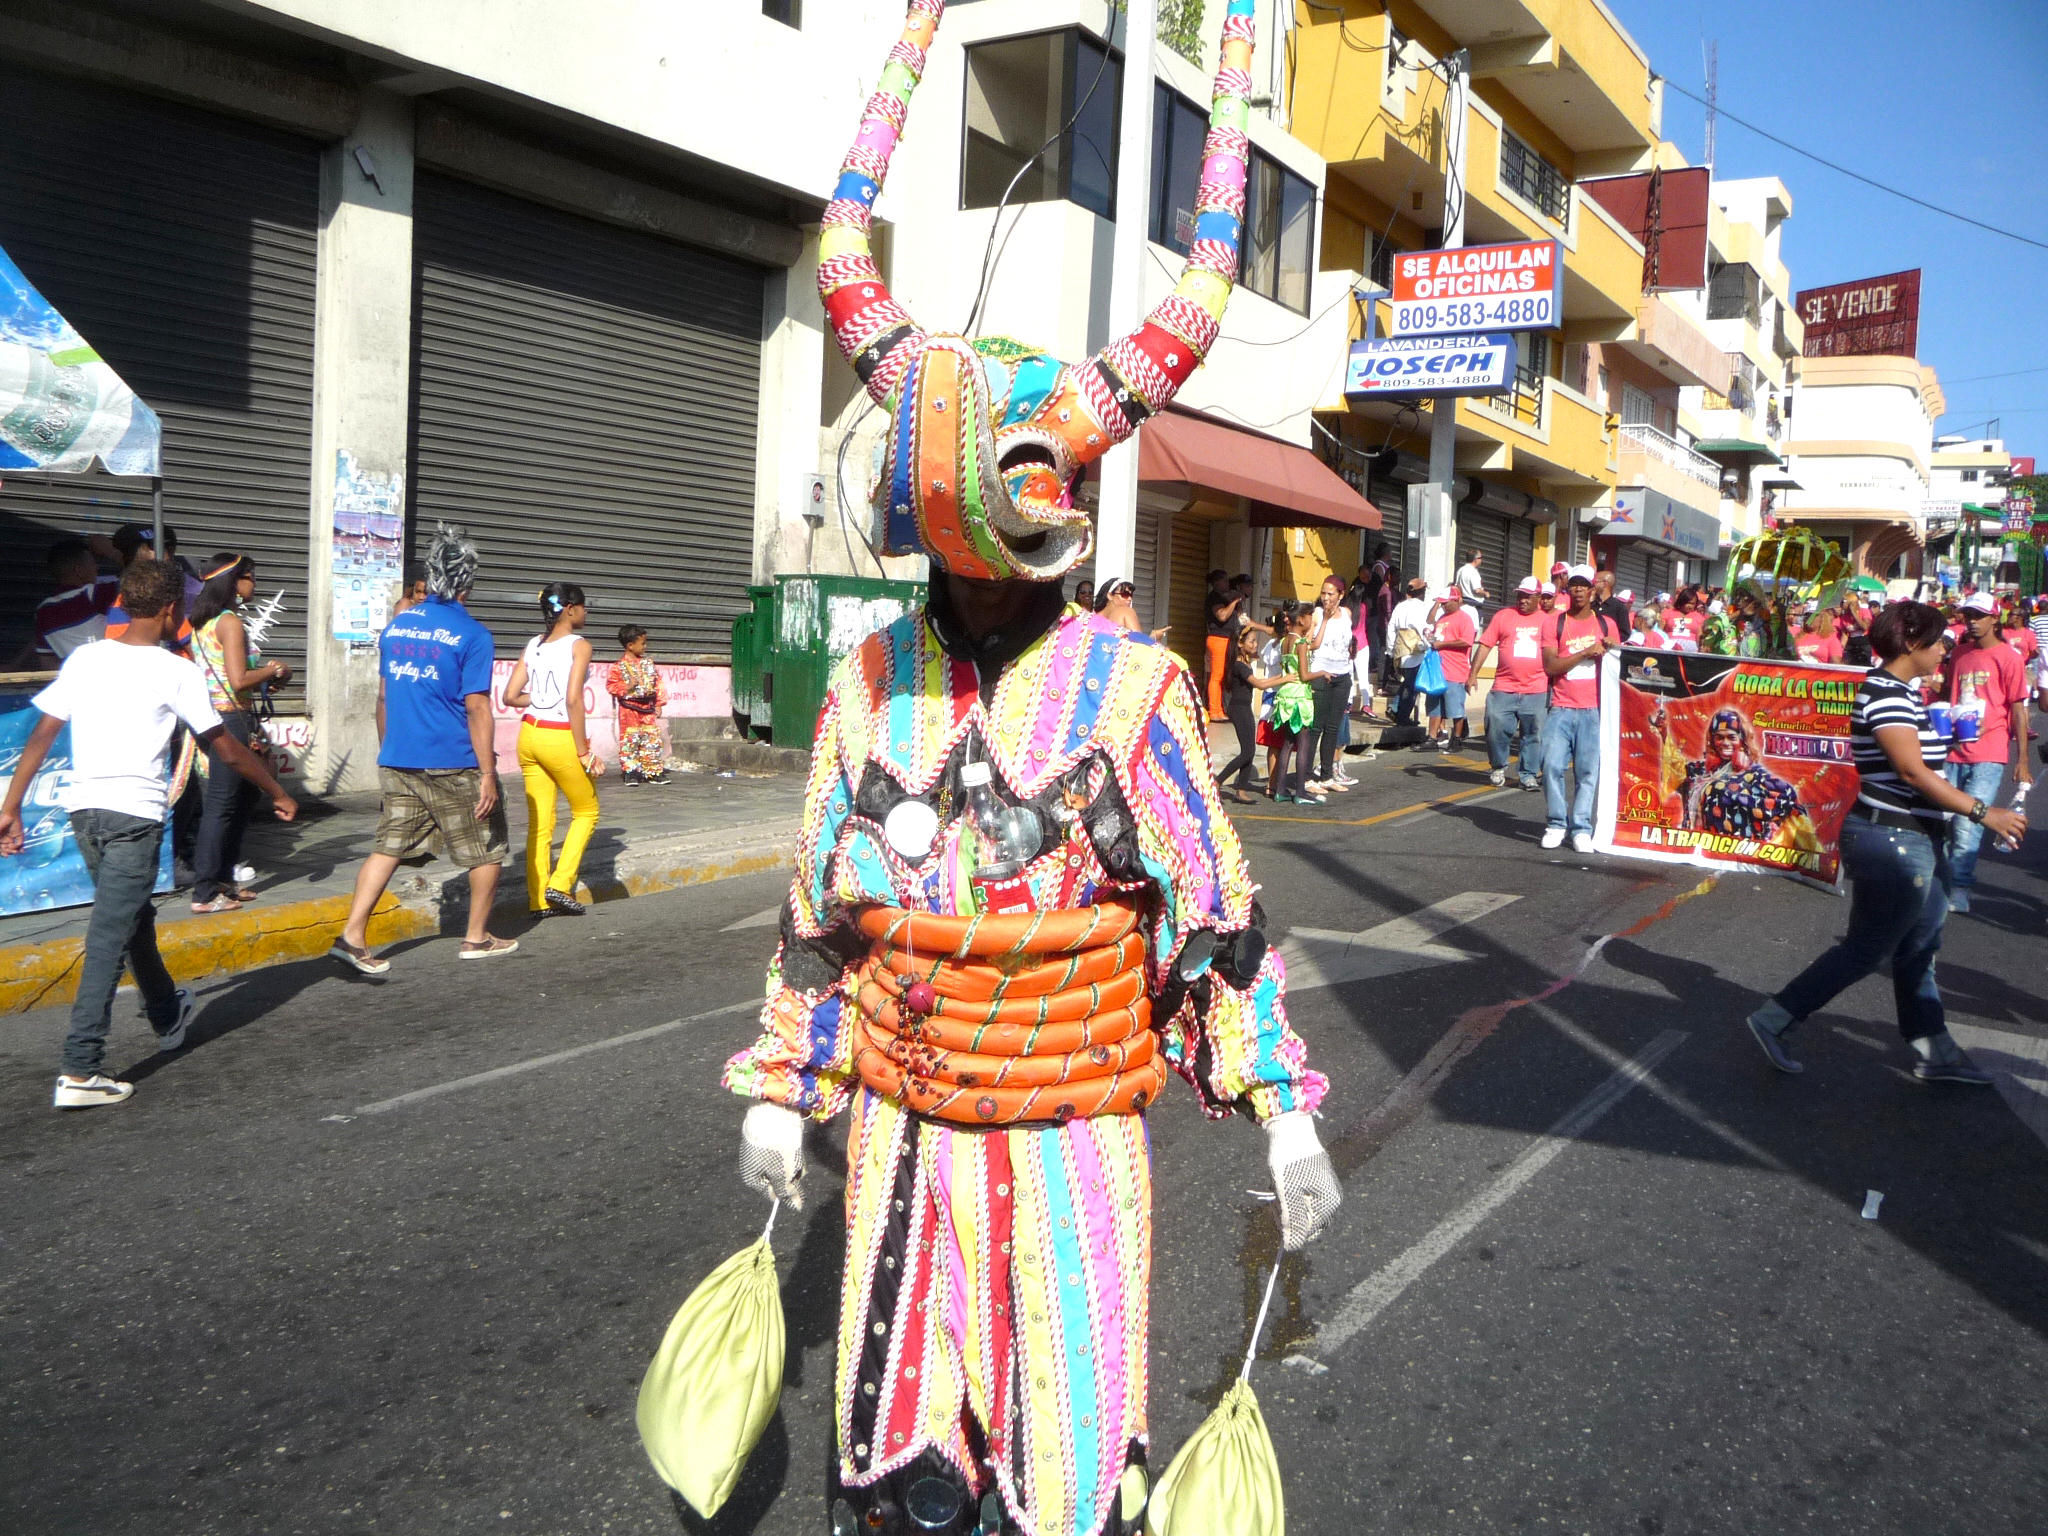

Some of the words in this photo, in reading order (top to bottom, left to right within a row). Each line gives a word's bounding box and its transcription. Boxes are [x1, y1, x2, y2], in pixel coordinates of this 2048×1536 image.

[1403, 257, 1430, 278] SE
[1436, 247, 1550, 274] ALQUILAN
[1414, 270, 1535, 298] OFICINAS
[1399, 297, 1549, 330] 809-583-4880
[1805, 296, 1827, 325] SE
[1832, 284, 1899, 319] VENDE
[1367, 336, 1490, 353] LAVANDERIA
[1357, 352, 1494, 378] JOSEPH
[1384, 374, 1490, 388] 809-583-4880
[1786, 678, 1808, 699] LA
[1638, 788, 1652, 808] 9
[1641, 826, 1662, 845] LA
